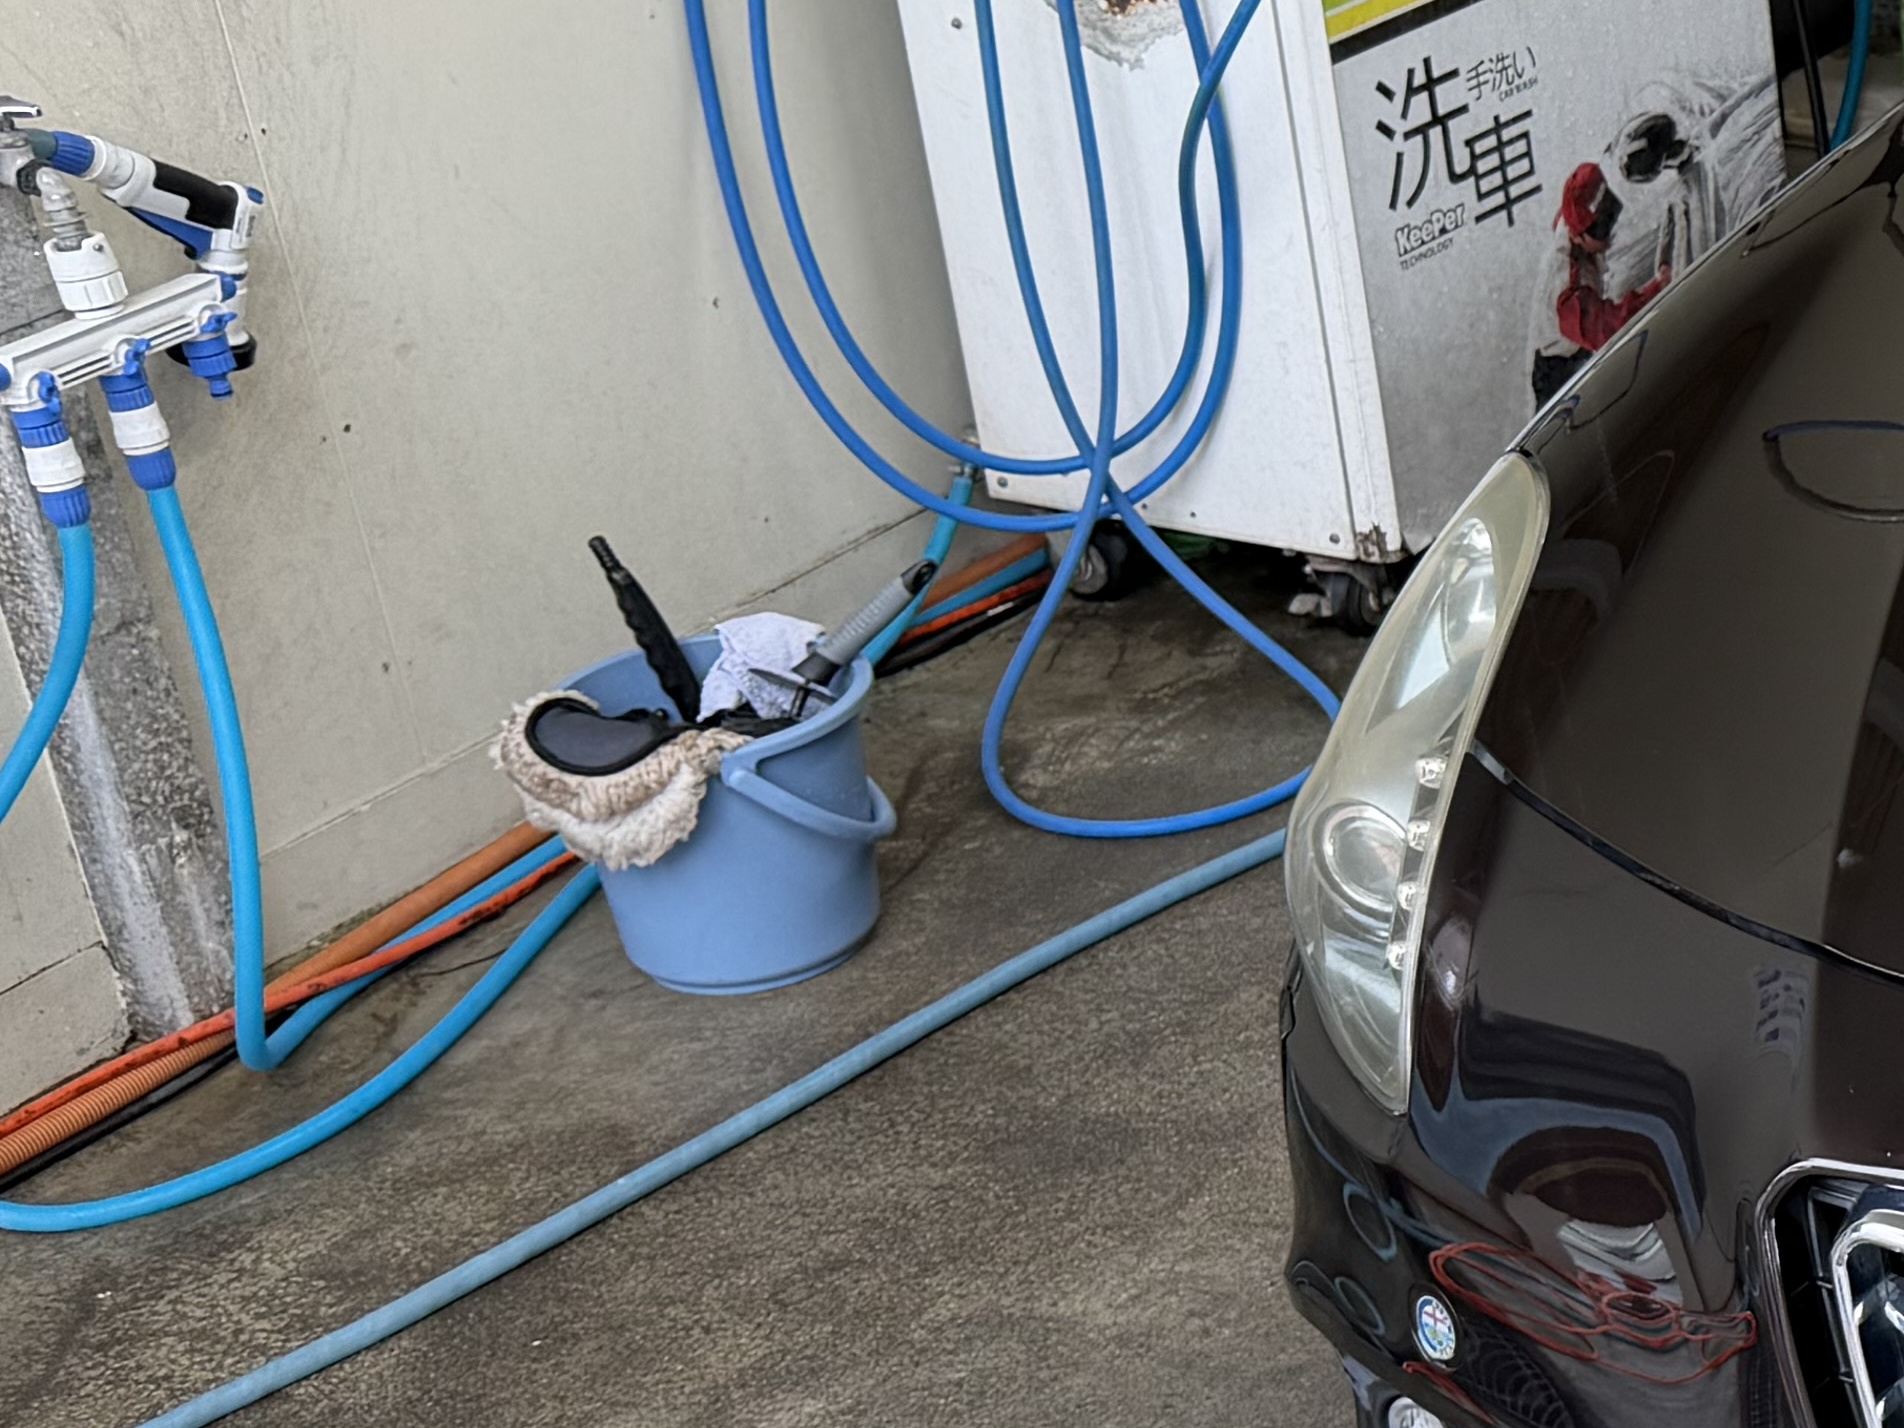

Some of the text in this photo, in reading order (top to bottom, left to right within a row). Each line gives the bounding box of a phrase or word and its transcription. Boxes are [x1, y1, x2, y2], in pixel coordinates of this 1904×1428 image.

[1466, 46, 1537, 101] 手洗い
[1395, 203, 1466, 258] KeePer
